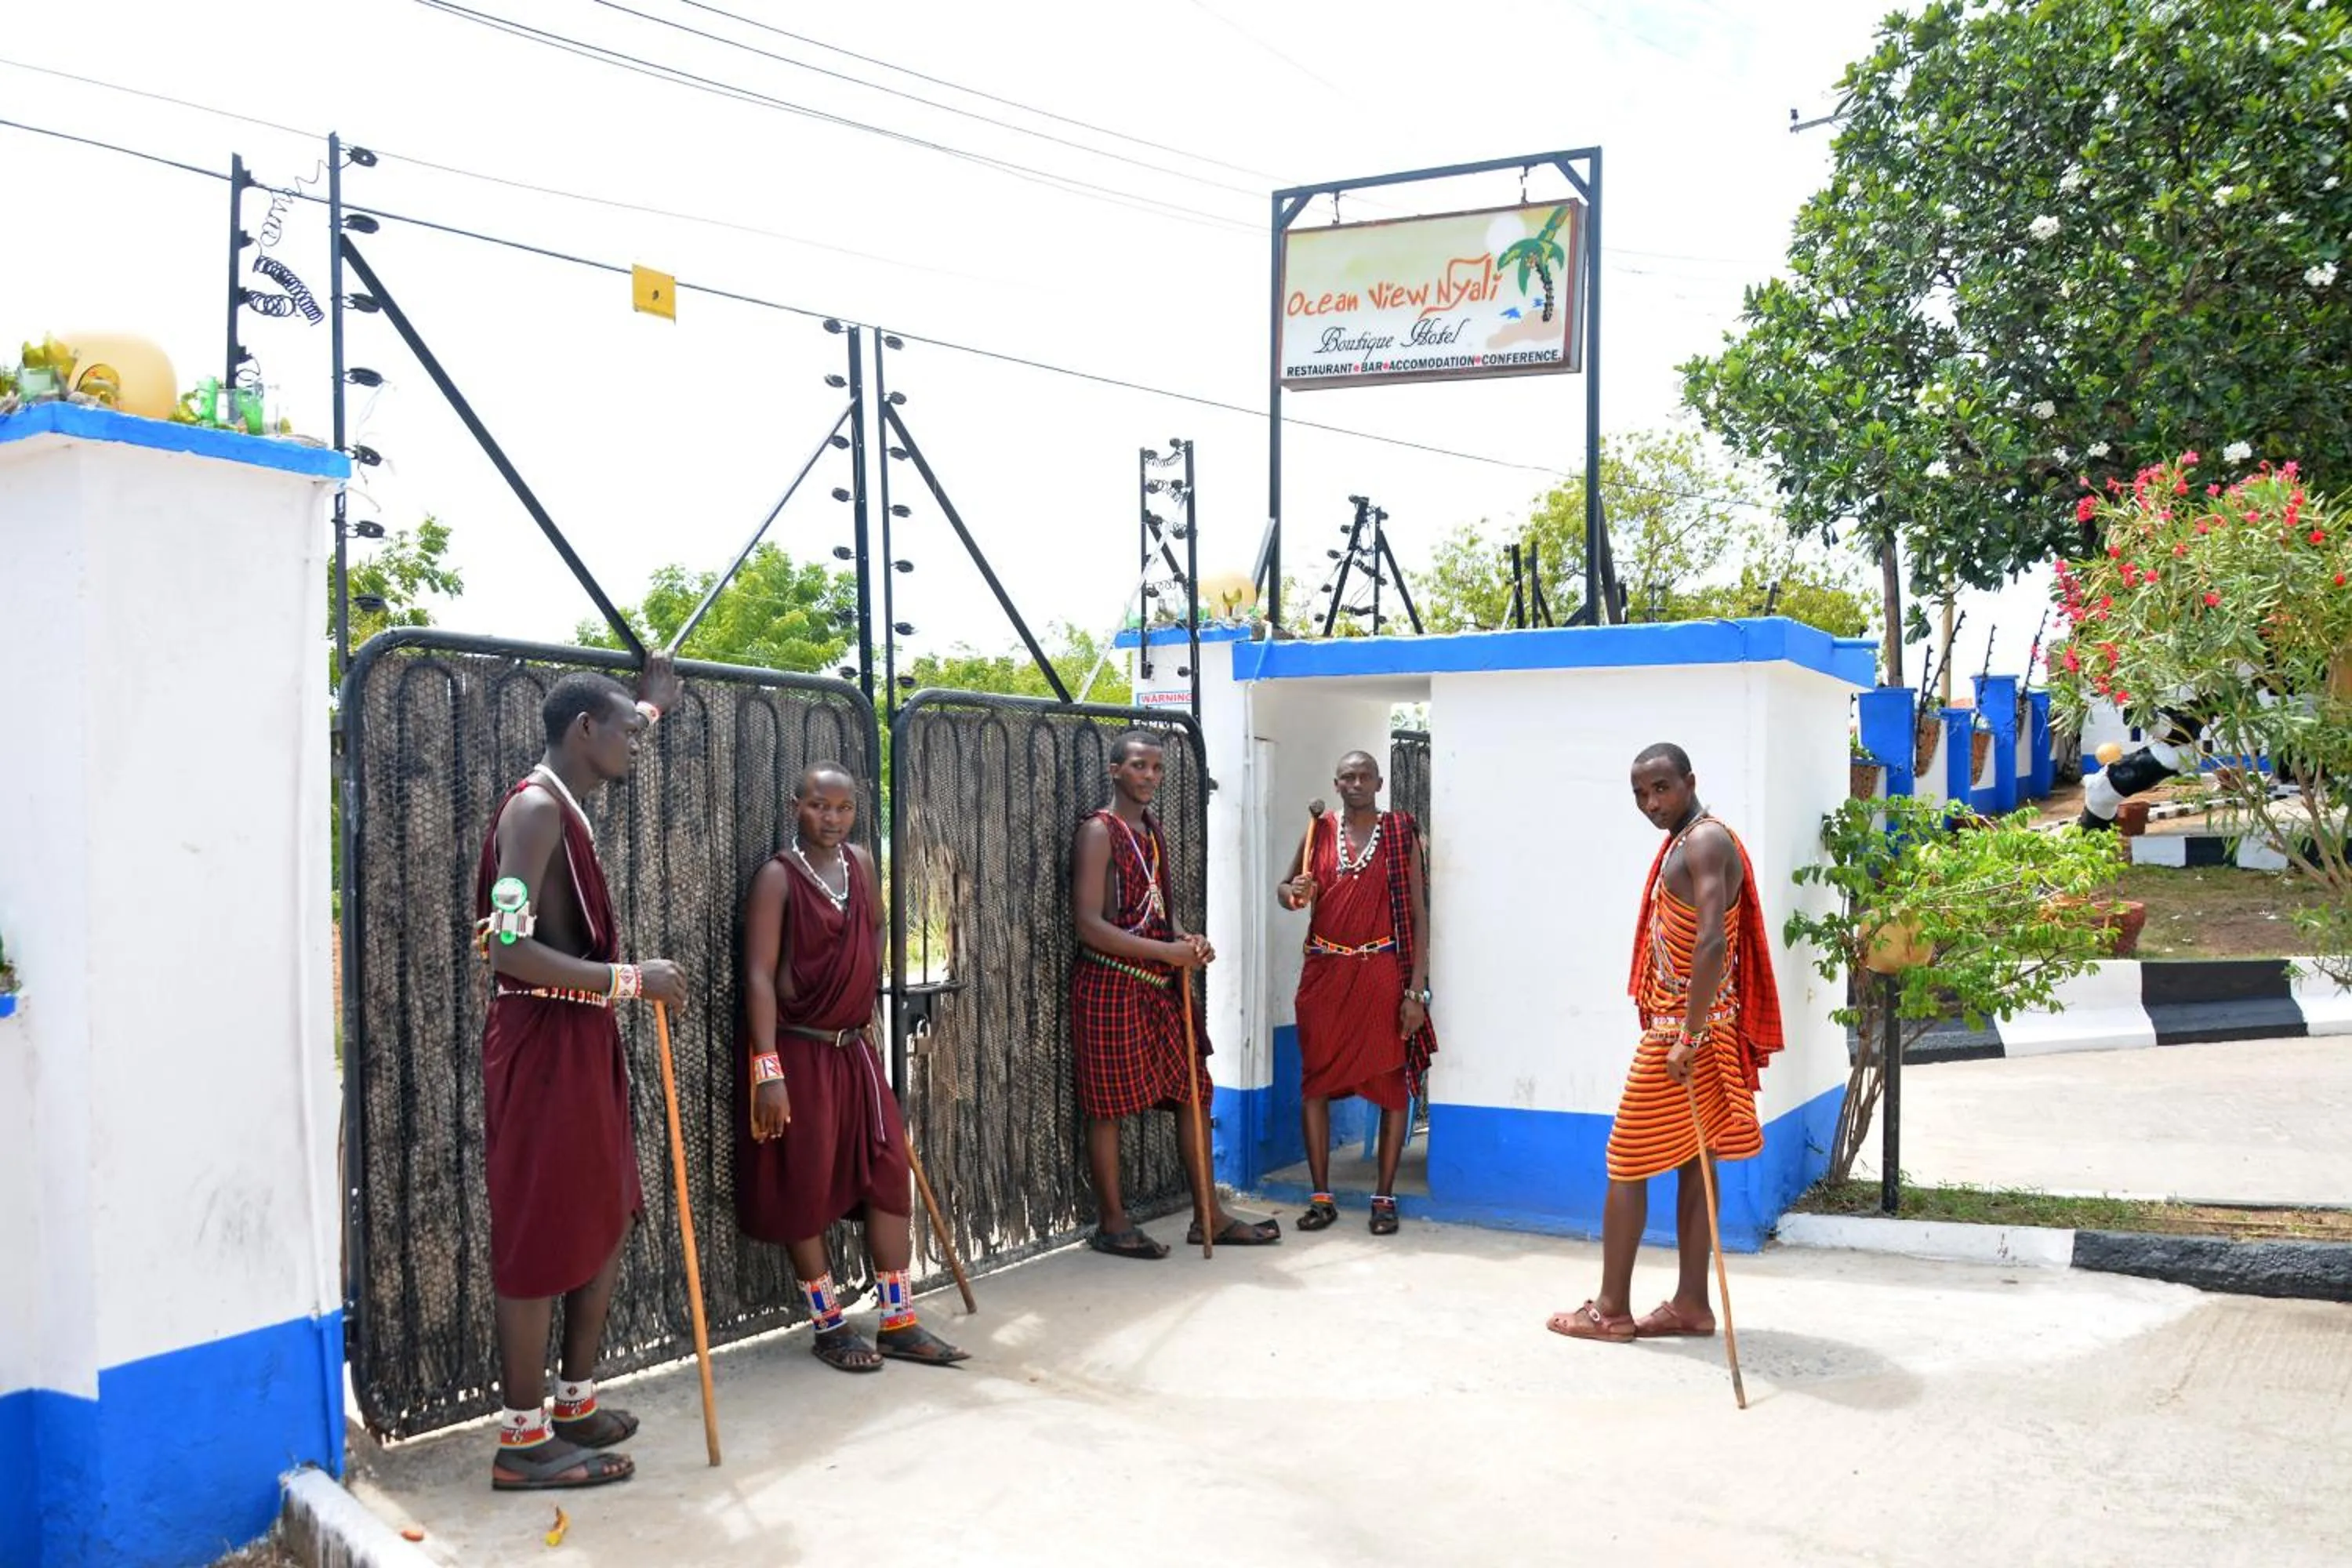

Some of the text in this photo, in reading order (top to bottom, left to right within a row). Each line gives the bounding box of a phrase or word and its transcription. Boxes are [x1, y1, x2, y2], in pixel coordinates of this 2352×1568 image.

[1287, 252, 1503, 318] Ocean View Nyali
[1313, 318, 1471, 361] Boutique Hotel
[1287, 363, 1352, 377] RESTAURANT
[1361, 361, 1382, 373] BAR
[1388, 356, 1475, 372] ACCOMODATION
